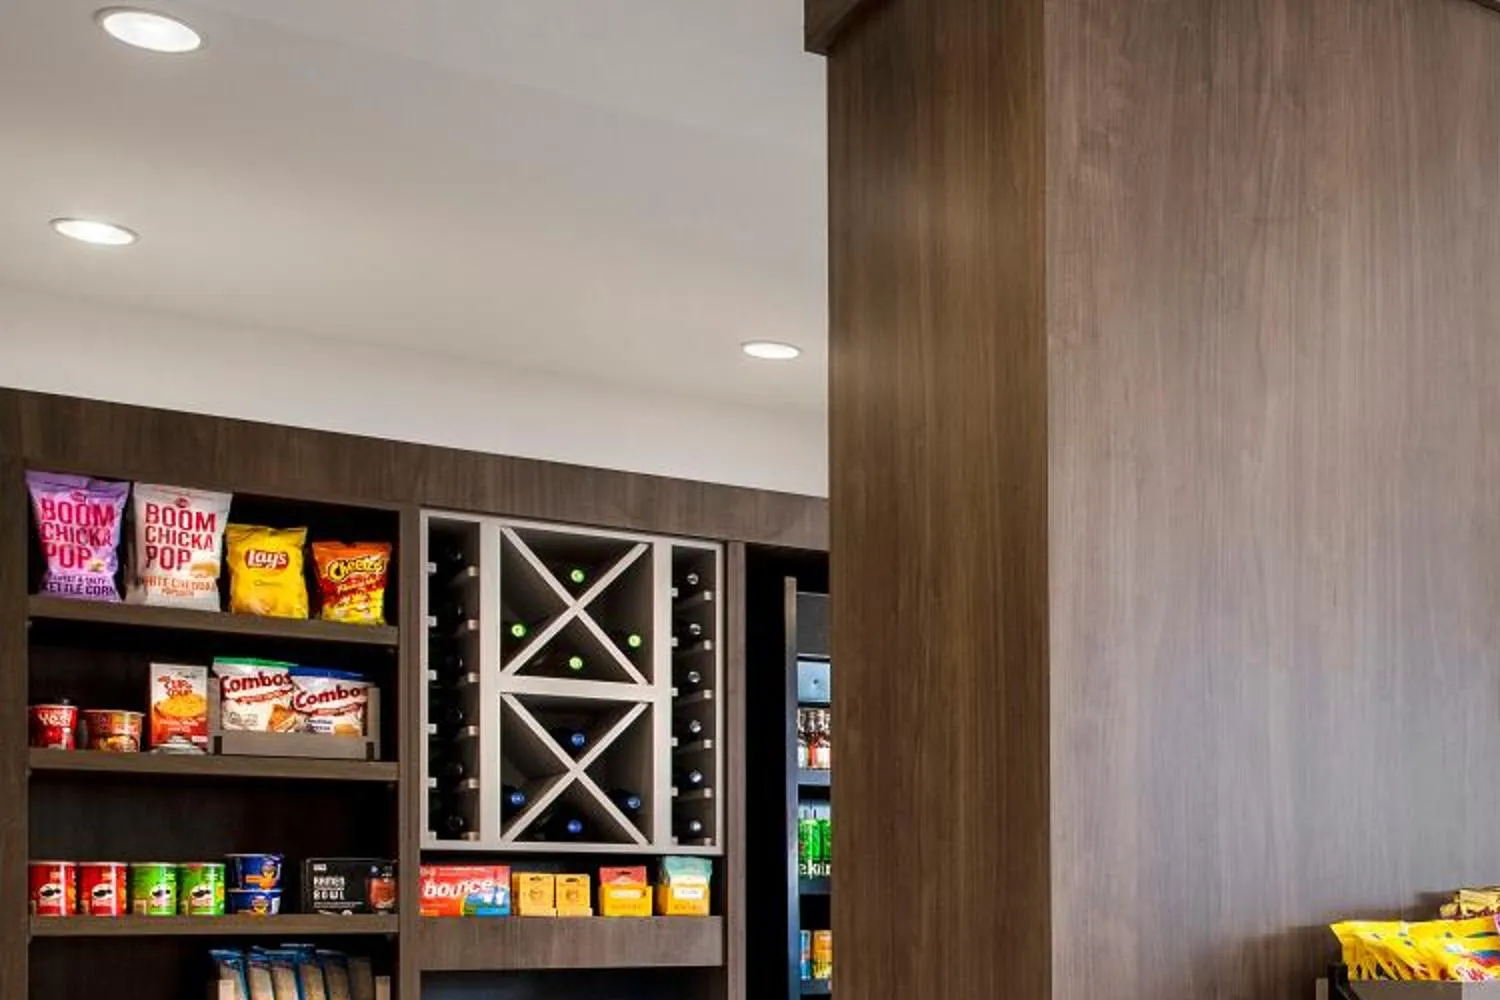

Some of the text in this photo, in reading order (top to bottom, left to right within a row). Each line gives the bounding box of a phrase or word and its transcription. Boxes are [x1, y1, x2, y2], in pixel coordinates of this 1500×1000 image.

[40, 497, 114, 527] BOOM
[145, 503, 216, 533] BOOM
[40, 521, 112, 547] CHICKA
[145, 525, 214, 552] CHICKA
[42, 542, 92, 569] POP
[145, 546, 192, 571] POP
[220, 671, 293, 693] Combos
